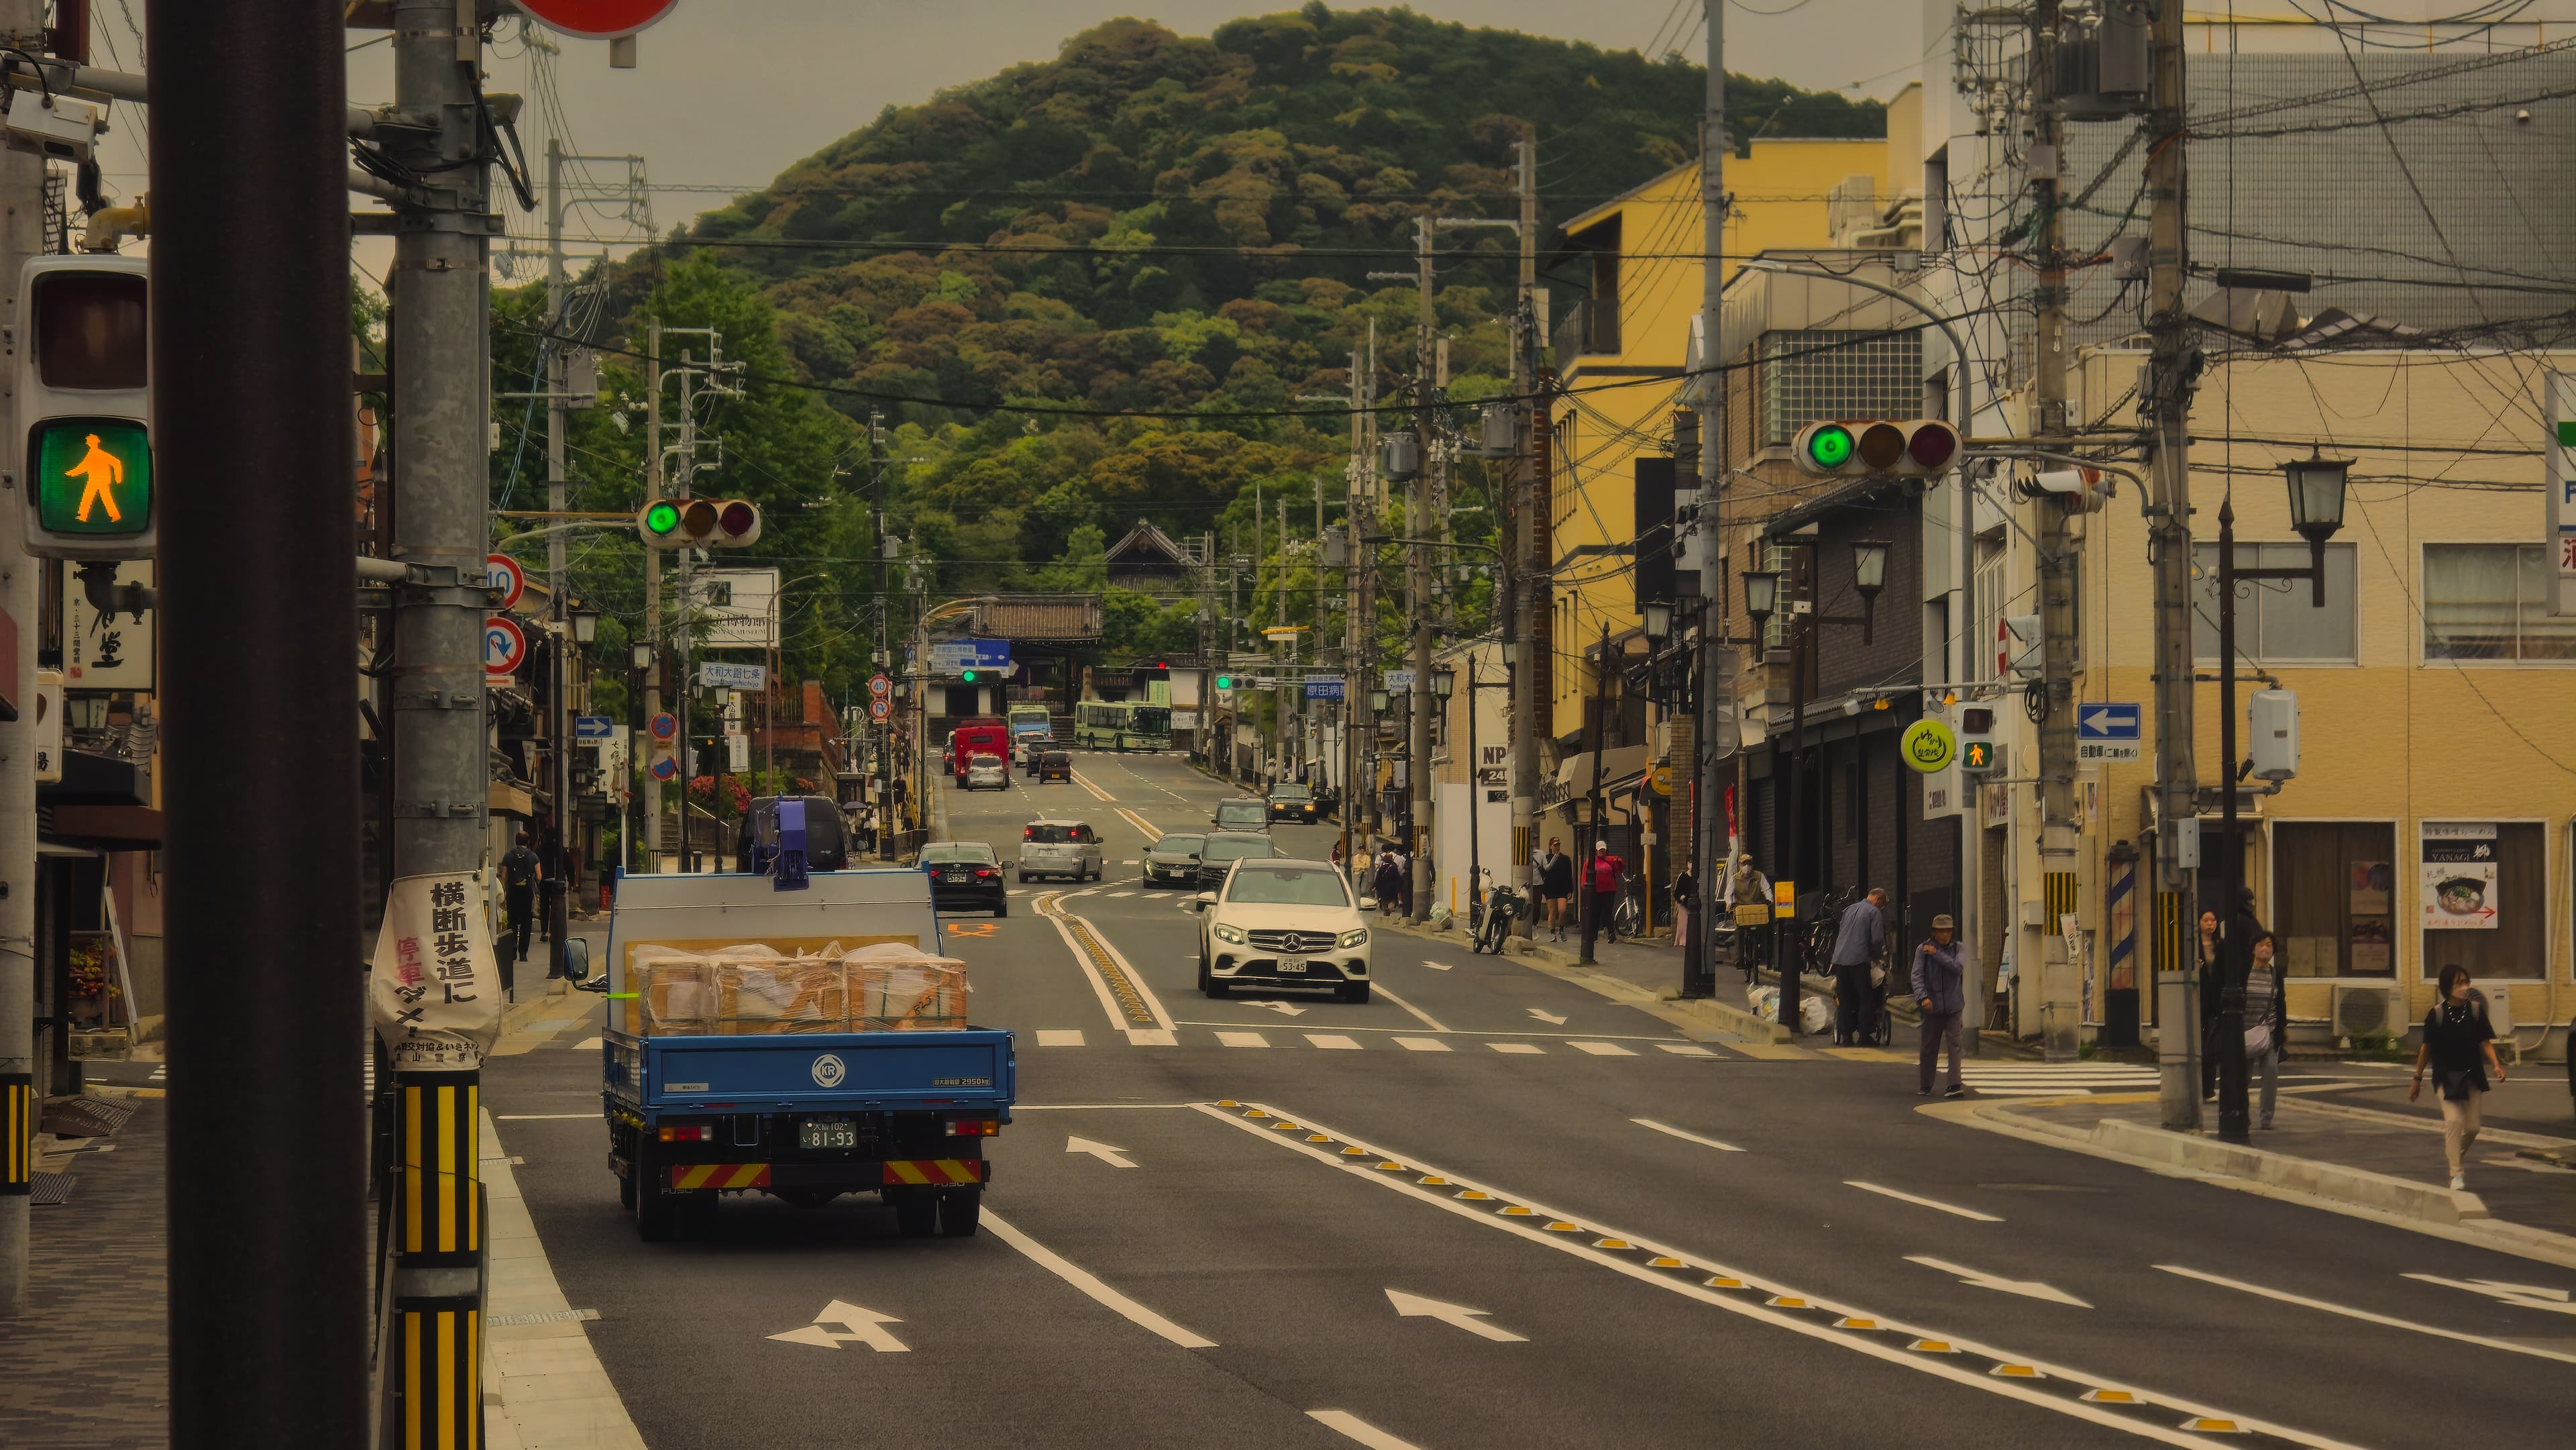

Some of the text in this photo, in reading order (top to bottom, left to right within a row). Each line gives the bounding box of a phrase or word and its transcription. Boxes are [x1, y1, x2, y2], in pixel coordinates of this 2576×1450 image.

[705, 666, 759, 679] 大和大路七条
[873, 681, 885, 690] 40
[430, 881, 478, 1004] 横断歩道に
[1283, 963, 1305, 971] 53-45
[821, 1066, 835, 1076] KR
[831, 1123, 845, 1131] 102
[812, 1132, 854, 1147] 81-93
